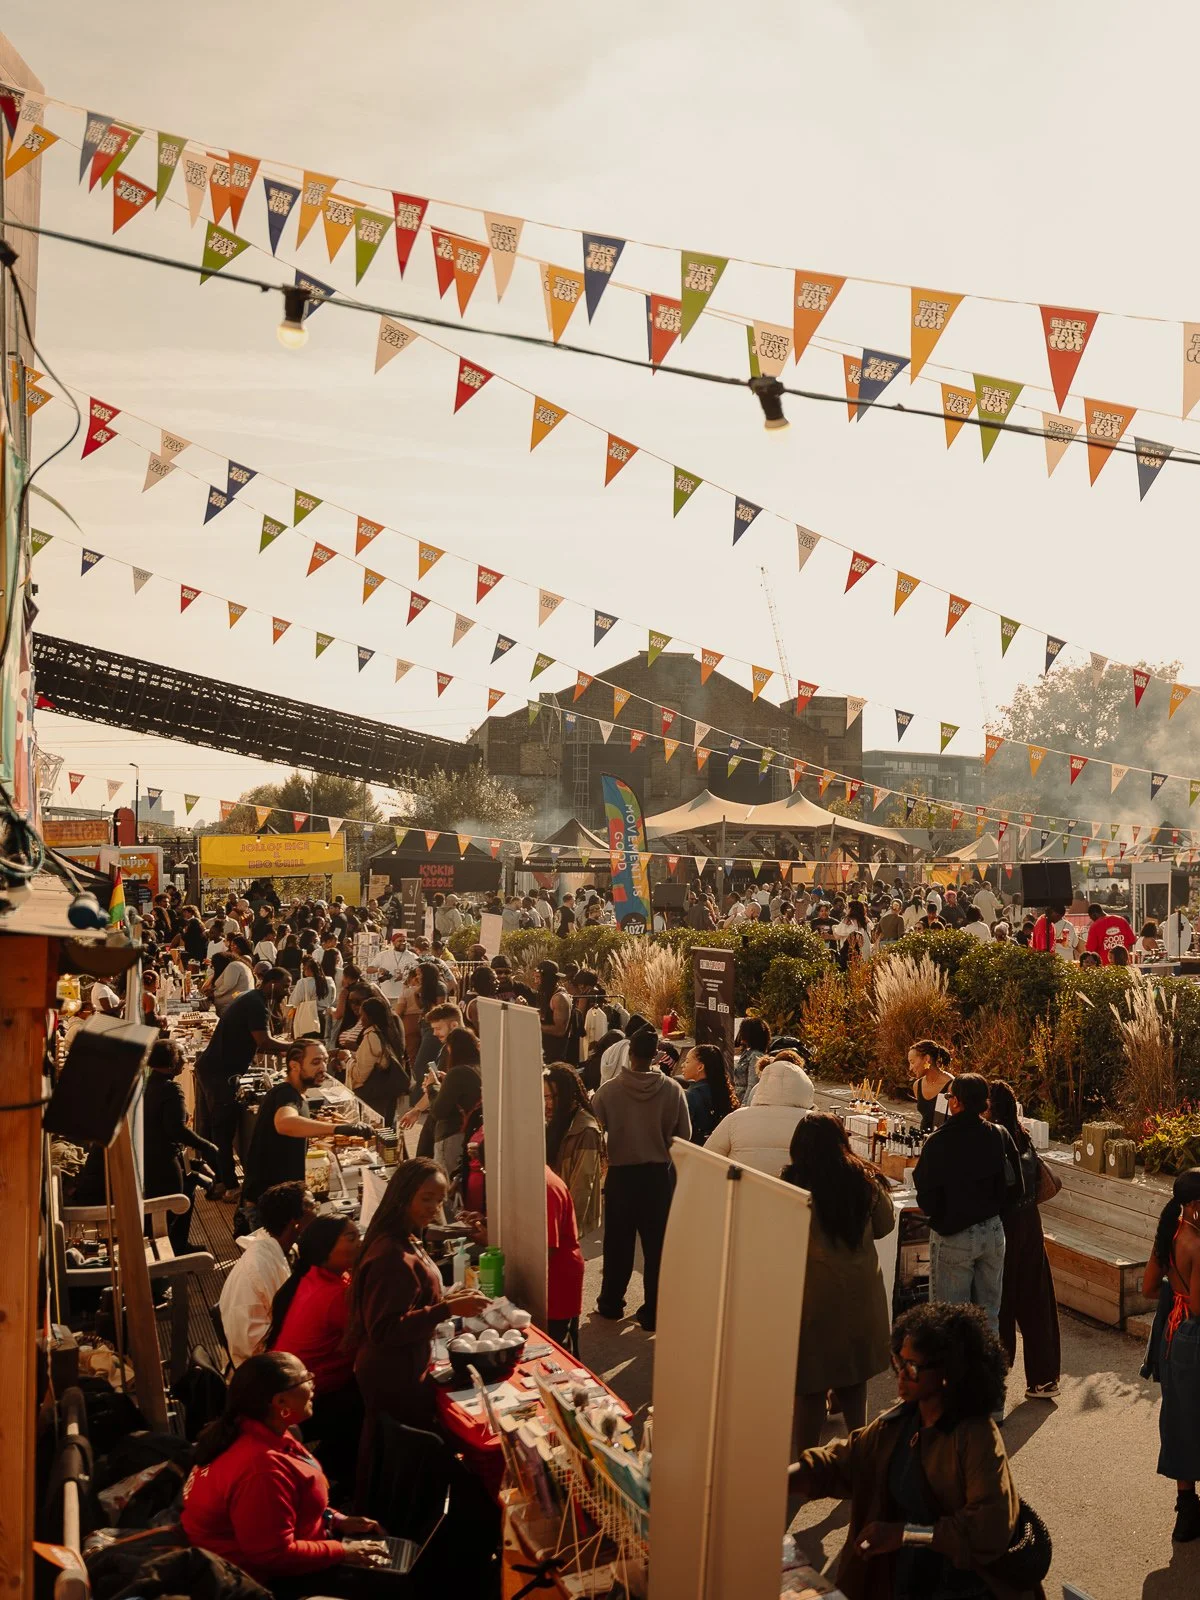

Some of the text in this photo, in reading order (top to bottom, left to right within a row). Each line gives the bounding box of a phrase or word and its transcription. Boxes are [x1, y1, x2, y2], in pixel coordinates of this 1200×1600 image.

[589, 243, 617, 256] BLACK
[688, 262, 716, 275] BLACK
[802, 282, 832, 294] BLACK
[919, 301, 950, 312] BLACK
[1051, 318, 1087, 332] BLACK
[761, 332, 789, 345] BLACK
[1053, 328, 1083, 338] EATS
[868, 357, 899, 370] BLACK
[982, 386, 1012, 399] BLACK
[1093, 410, 1124, 423] BLACK
[614, 831, 626, 871] GOOD
[625, 804, 642, 897] MOVEMENT IS
[274, 859, 306, 868] GRILL
[624, 924, 645, 935] 1027
